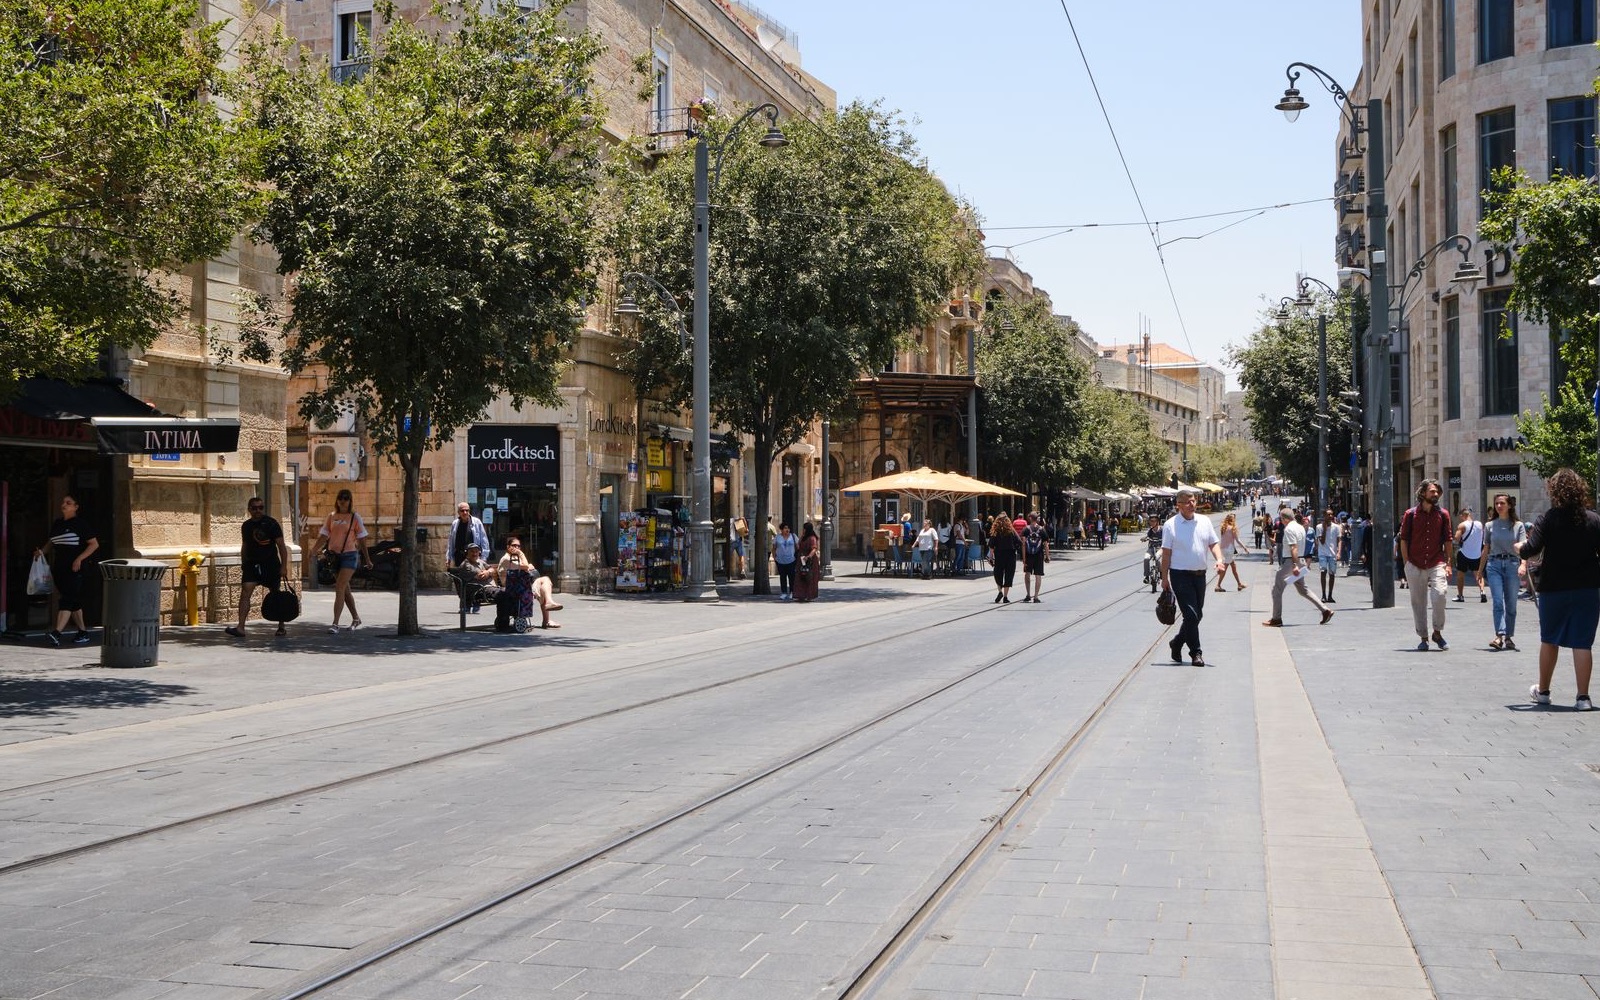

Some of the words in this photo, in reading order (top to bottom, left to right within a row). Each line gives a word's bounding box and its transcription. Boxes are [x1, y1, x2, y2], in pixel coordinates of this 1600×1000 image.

[144, 430, 203, 450] INTIMA
[469, 438, 556, 460] LordKitsch
[488, 462, 538, 472] OUTLET
[1488, 474, 1518, 482] MASHBIR
